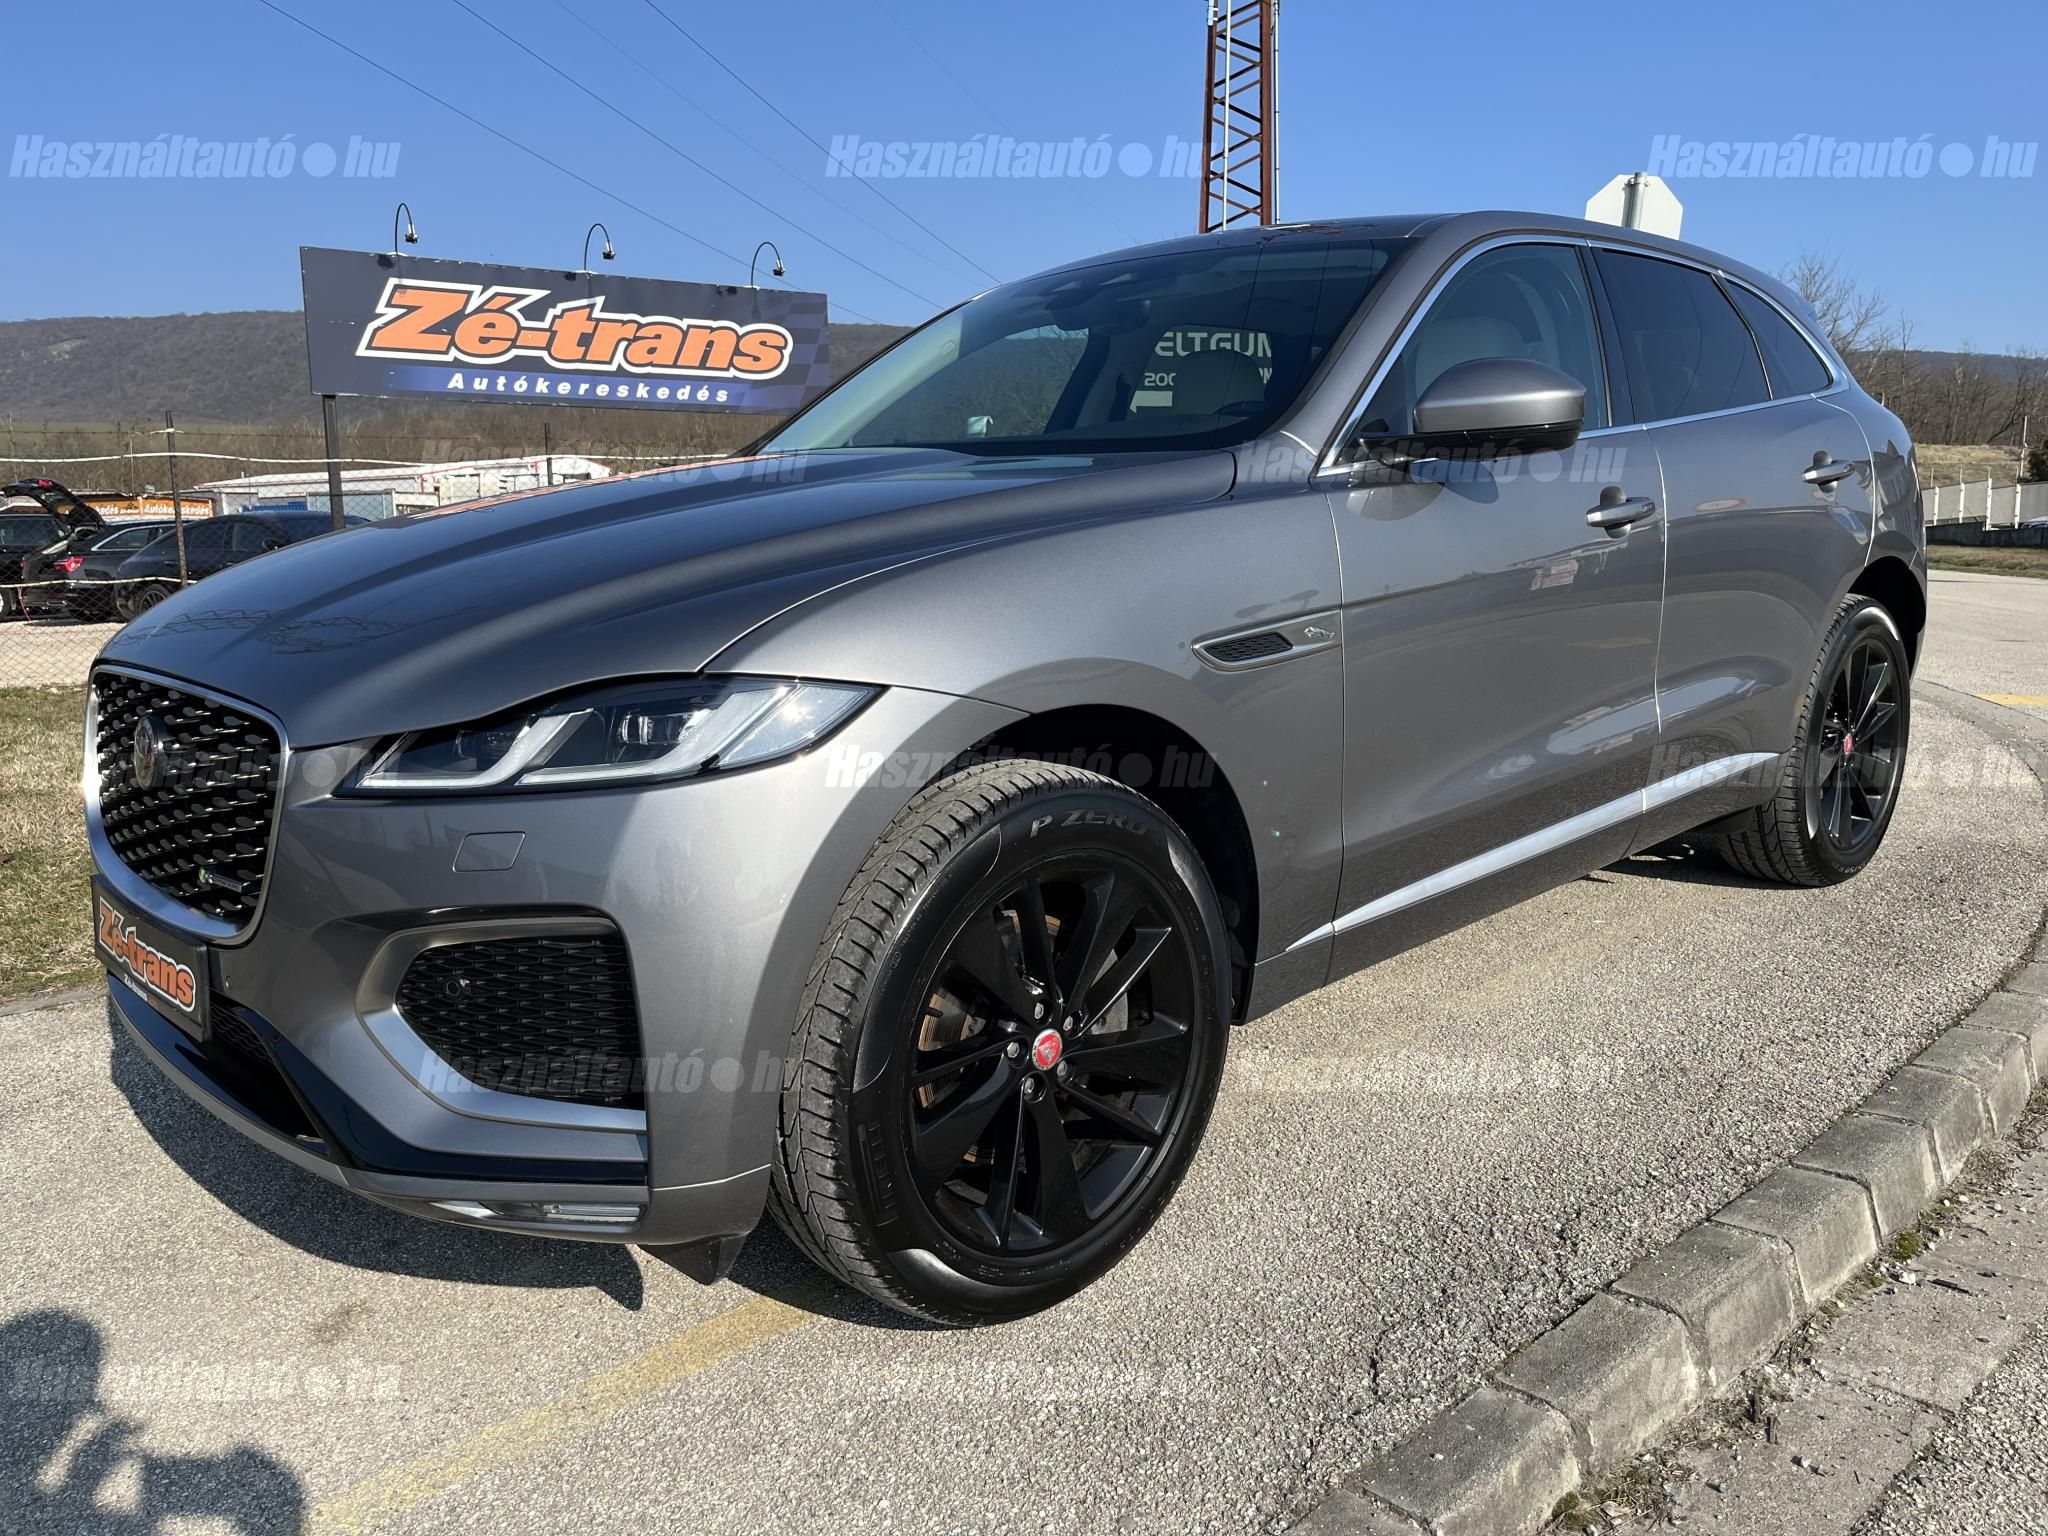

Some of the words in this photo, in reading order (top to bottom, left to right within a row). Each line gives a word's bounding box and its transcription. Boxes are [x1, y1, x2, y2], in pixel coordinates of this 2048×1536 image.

[357, 278, 793, 380] Zé-trans
[447, 372, 729, 403] Autókereskedés
[1030, 815, 1053, 838] P
[1061, 807, 1147, 835] ZERO
[100, 897, 195, 1012] Zé-trans
